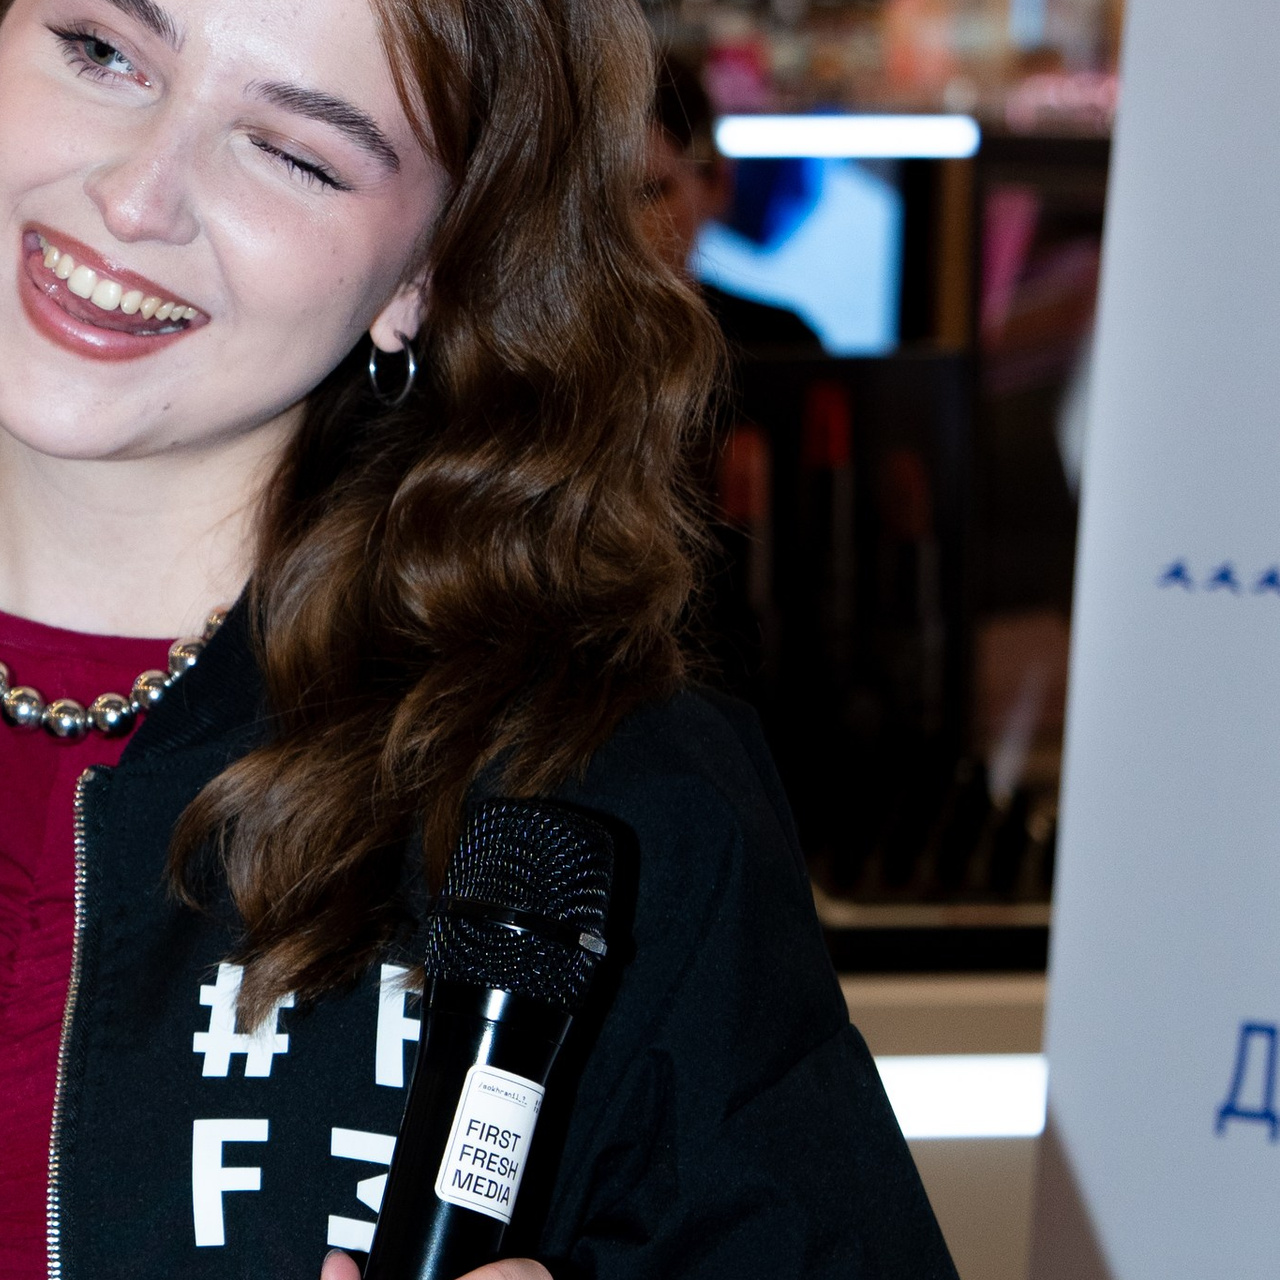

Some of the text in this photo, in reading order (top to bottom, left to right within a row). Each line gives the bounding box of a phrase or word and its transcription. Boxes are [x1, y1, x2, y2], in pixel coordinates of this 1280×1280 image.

[466, 1118, 521, 1152] FIRST
[459, 1144, 519, 1181] FRESH
[452, 1169, 511, 1206] MEDIA
